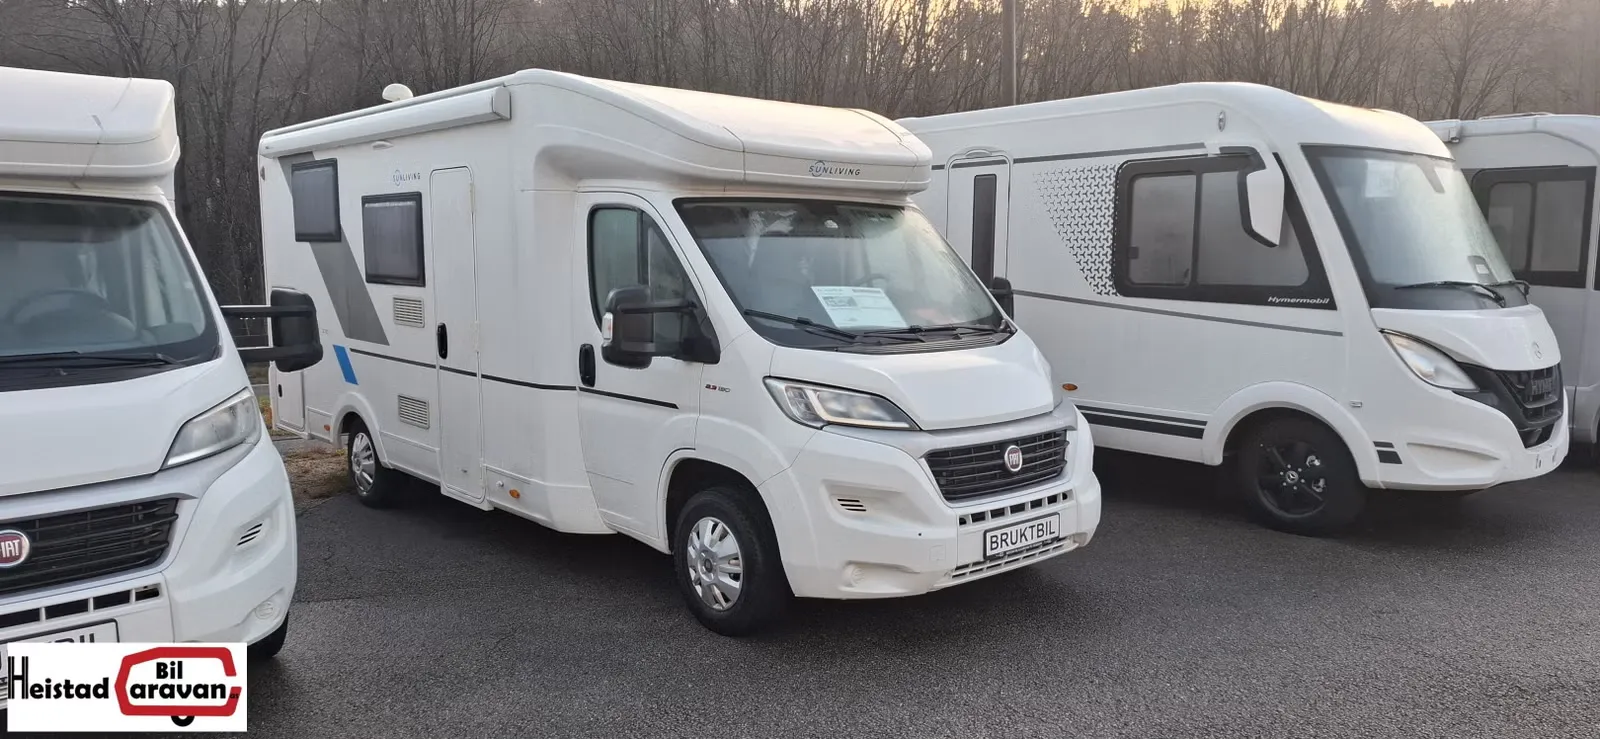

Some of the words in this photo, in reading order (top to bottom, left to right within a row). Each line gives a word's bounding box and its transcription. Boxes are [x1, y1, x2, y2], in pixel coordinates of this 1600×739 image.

[808, 163, 861, 176] SUNLIVING
[392, 171, 421, 184] SUNLIVING
[1268, 296, 1330, 304] Hymermobil
[990, 520, 1056, 551] BRUKTBIL
[0, 539, 20, 558] IAT
